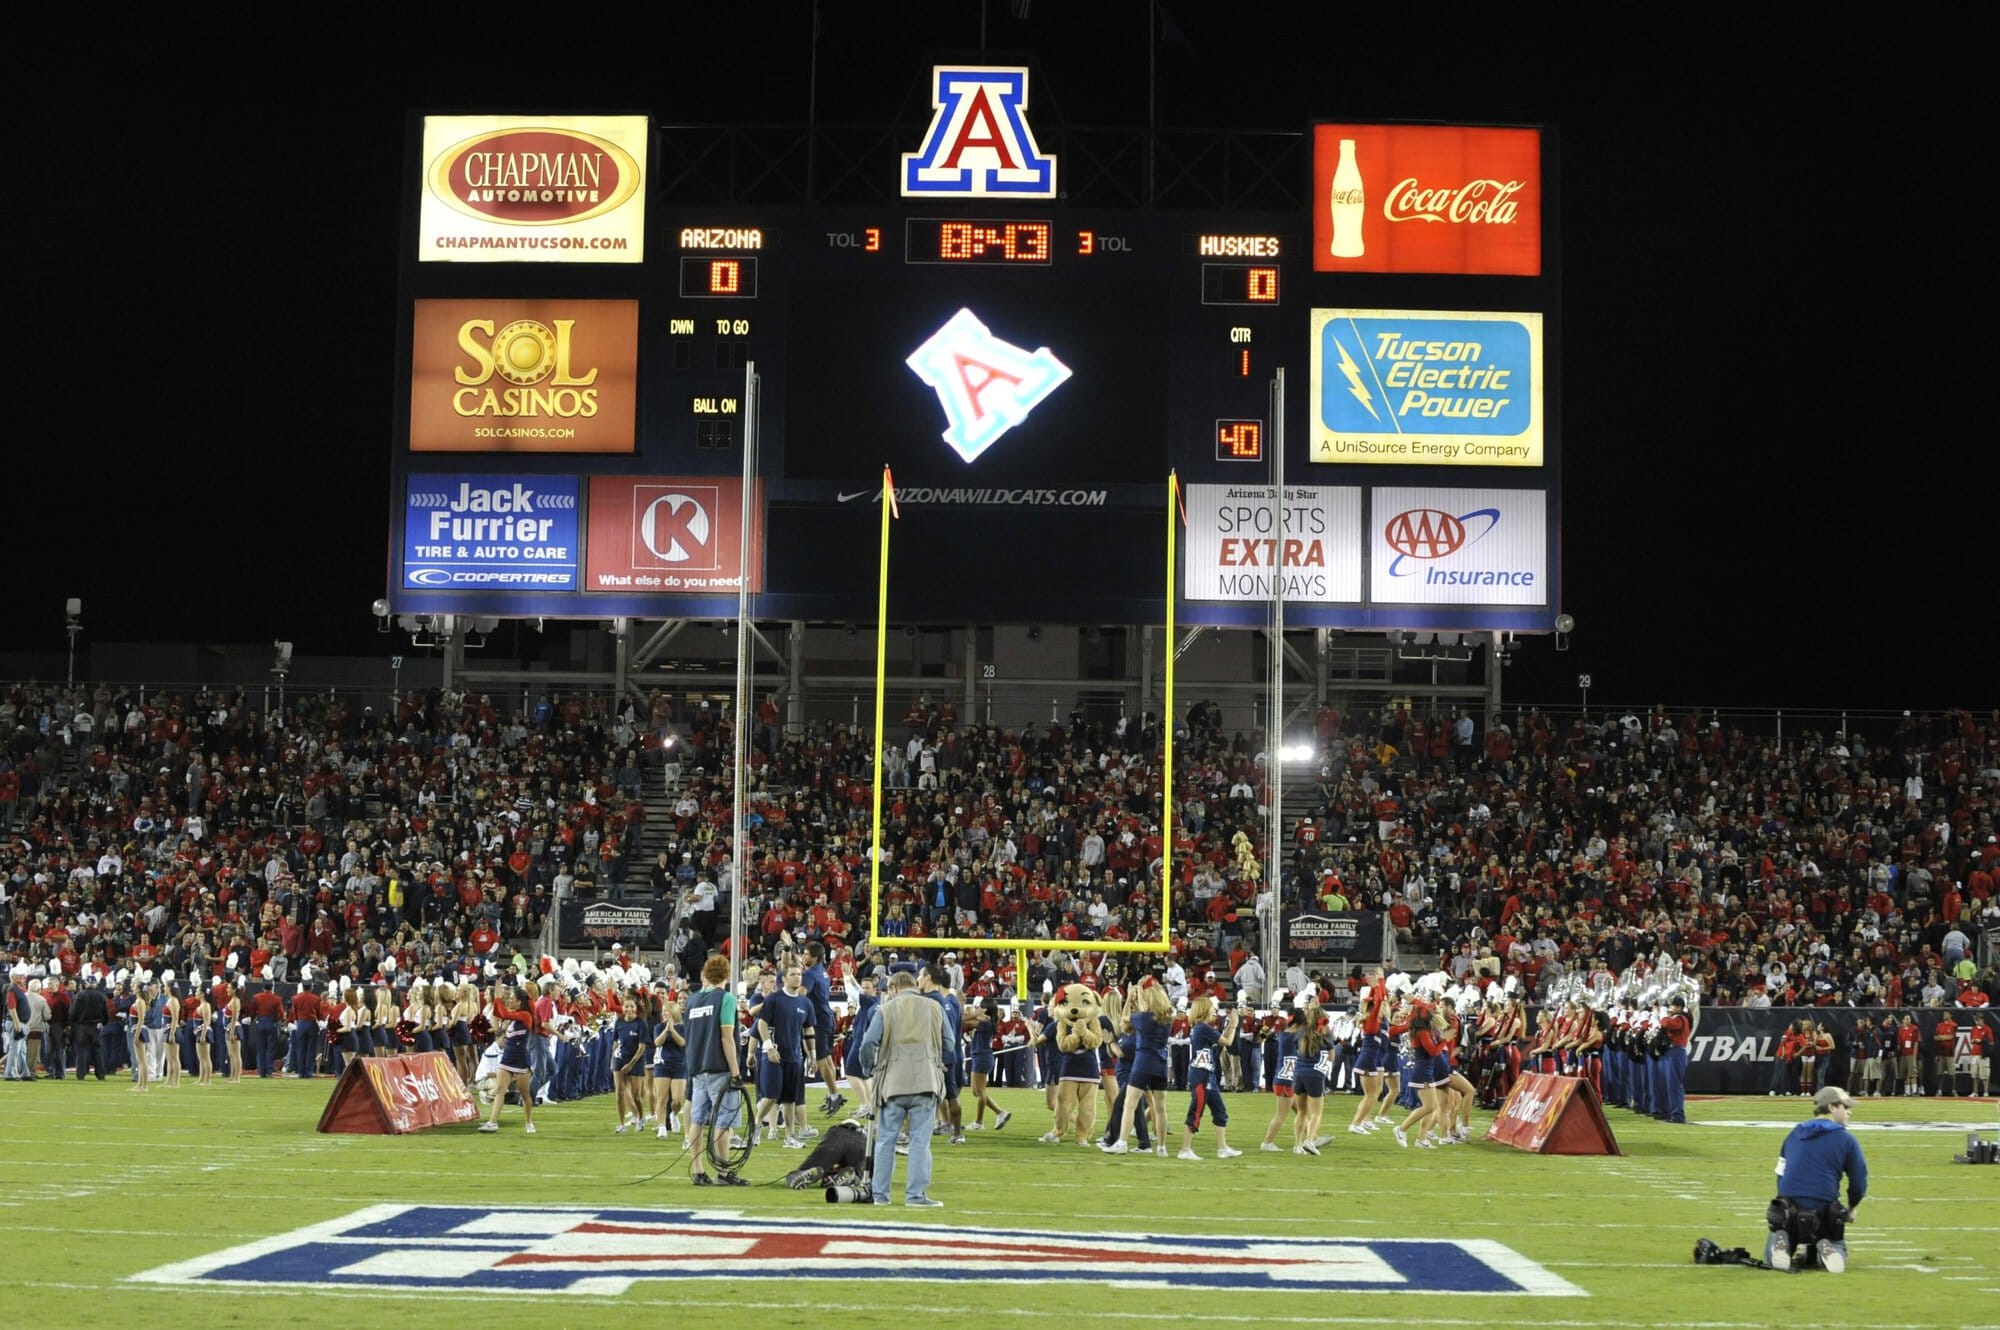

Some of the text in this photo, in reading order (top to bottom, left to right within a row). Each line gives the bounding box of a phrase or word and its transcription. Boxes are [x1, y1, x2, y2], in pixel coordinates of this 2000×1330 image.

[901, 66, 1057, 198] A
[464, 152, 603, 188] CHAPMAN
[467, 189, 600, 203] AUTOMOTIVE
[1383, 177, 1526, 225] Coca-Cola
[435, 236, 628, 250] CHAPMANTUCSON.COM
[680, 228, 762, 250] ARIZONA
[826, 233, 860, 248] TOL
[865, 228, 880, 251] 3
[940, 223, 1049, 260] 8:43
[1078, 231, 1093, 254] 3
[1098, 237, 1132, 252] TOL
[1200, 236, 1280, 257] HUSKIES
[710, 260, 739, 293] 0
[1248, 268, 1277, 301] 0
[670, 319, 694, 335] DWN
[716, 320, 749, 336] TO GO
[1230, 327, 1251, 343] QTR
[454, 318, 598, 386] SOL
[1375, 332, 1482, 363] Tucson
[1242, 350, 1249, 376] 1
[1385, 360, 1511, 391] Electric
[453, 387, 598, 418] CASINOS
[693, 398, 737, 414] BALL ON
[1398, 390, 1510, 419] Power
[474, 427, 575, 439] SOLCASINOS.COM
[1220, 424, 1259, 456] 40
[1320, 440, 1530, 458] A UniSource Energy Company
[451, 483, 534, 513] Jack
[1226, 488, 1318, 501] Arizona Daly Star
[430, 511, 553, 542] Furrier
[1217, 506, 1325, 534] SPORTS
[1395, 510, 1458, 557] AAA
[415, 546, 567, 560] TIRE & AUTO CARE
[1219, 538, 1325, 567] EXTRA
[598, 575, 751, 588] What else do you need
[1219, 574, 1327, 596] MONDAYS
[1426, 566, 1534, 586] Insurance
[391, 656, 403, 669] 27
[983, 664, 996, 678] 28
[1579, 674, 1591, 688] 29
[585, 910, 622, 918] AMERICAN
[1290, 922, 1328, 930] AMERICAN
[689, 1005, 714, 1020] ESPN
[1686, 1036, 1775, 1062] TBAL
